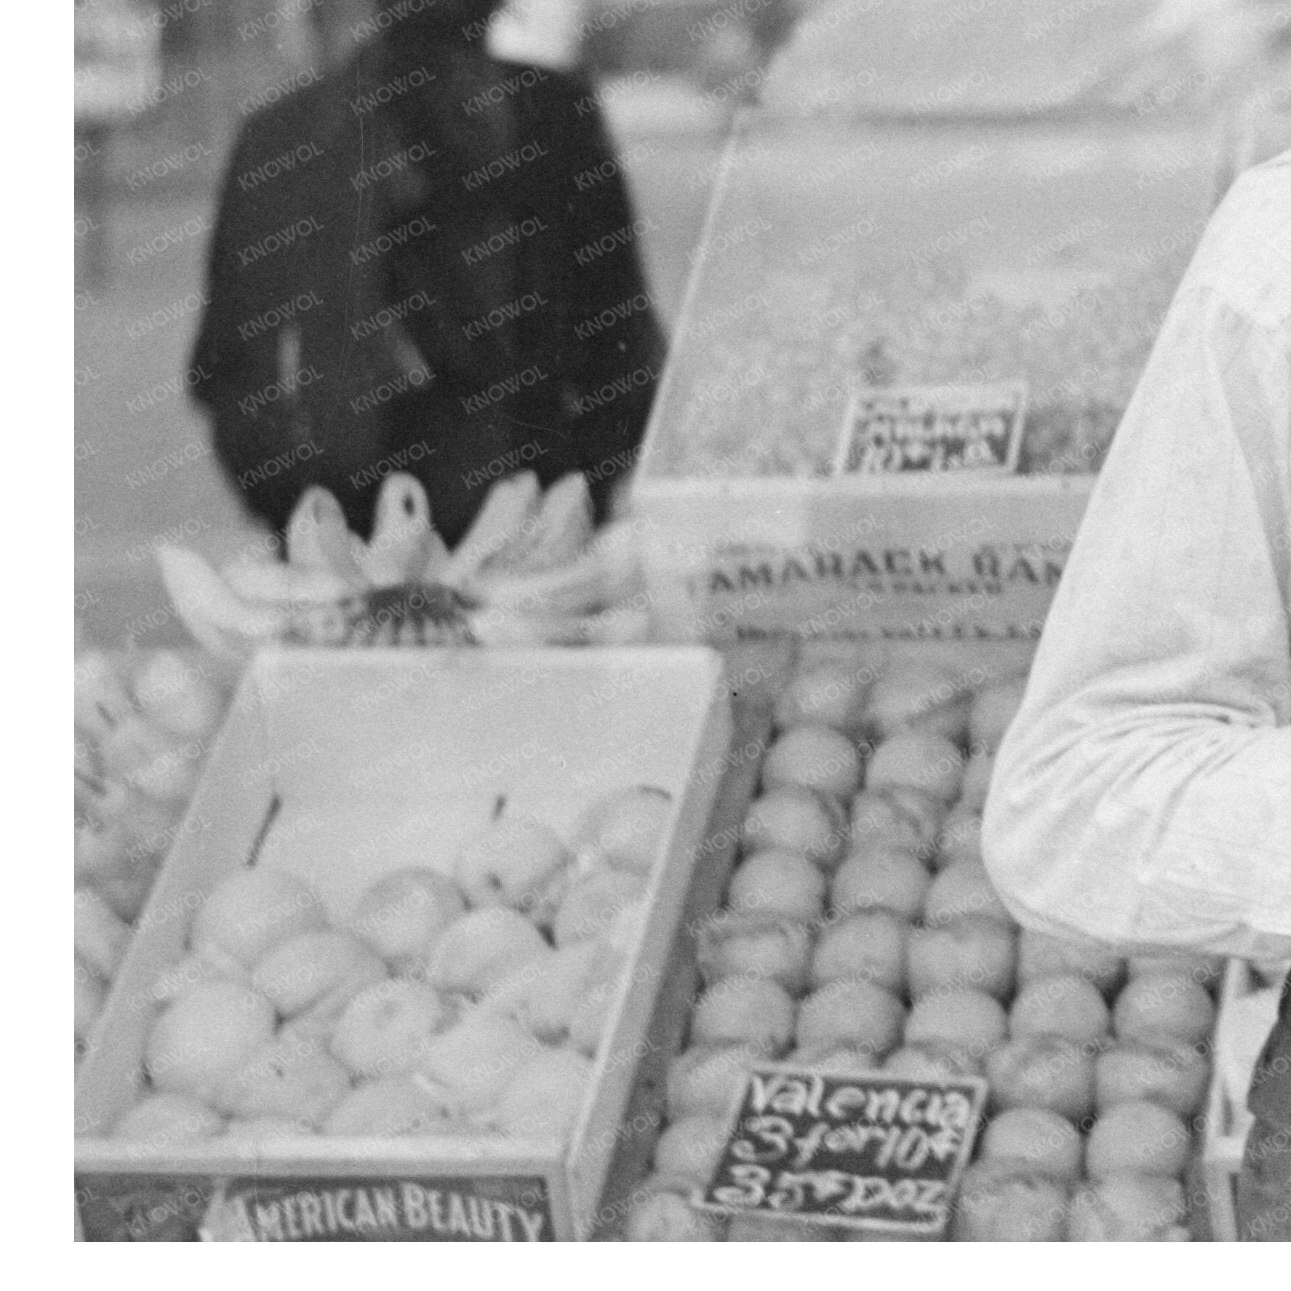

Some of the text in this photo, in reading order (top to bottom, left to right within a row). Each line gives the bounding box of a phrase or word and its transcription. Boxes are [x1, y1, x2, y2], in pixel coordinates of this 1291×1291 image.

[750, 1075, 971, 1128] Valencia
[222, 1181, 544, 1242] AMERICAN BEAUTY
